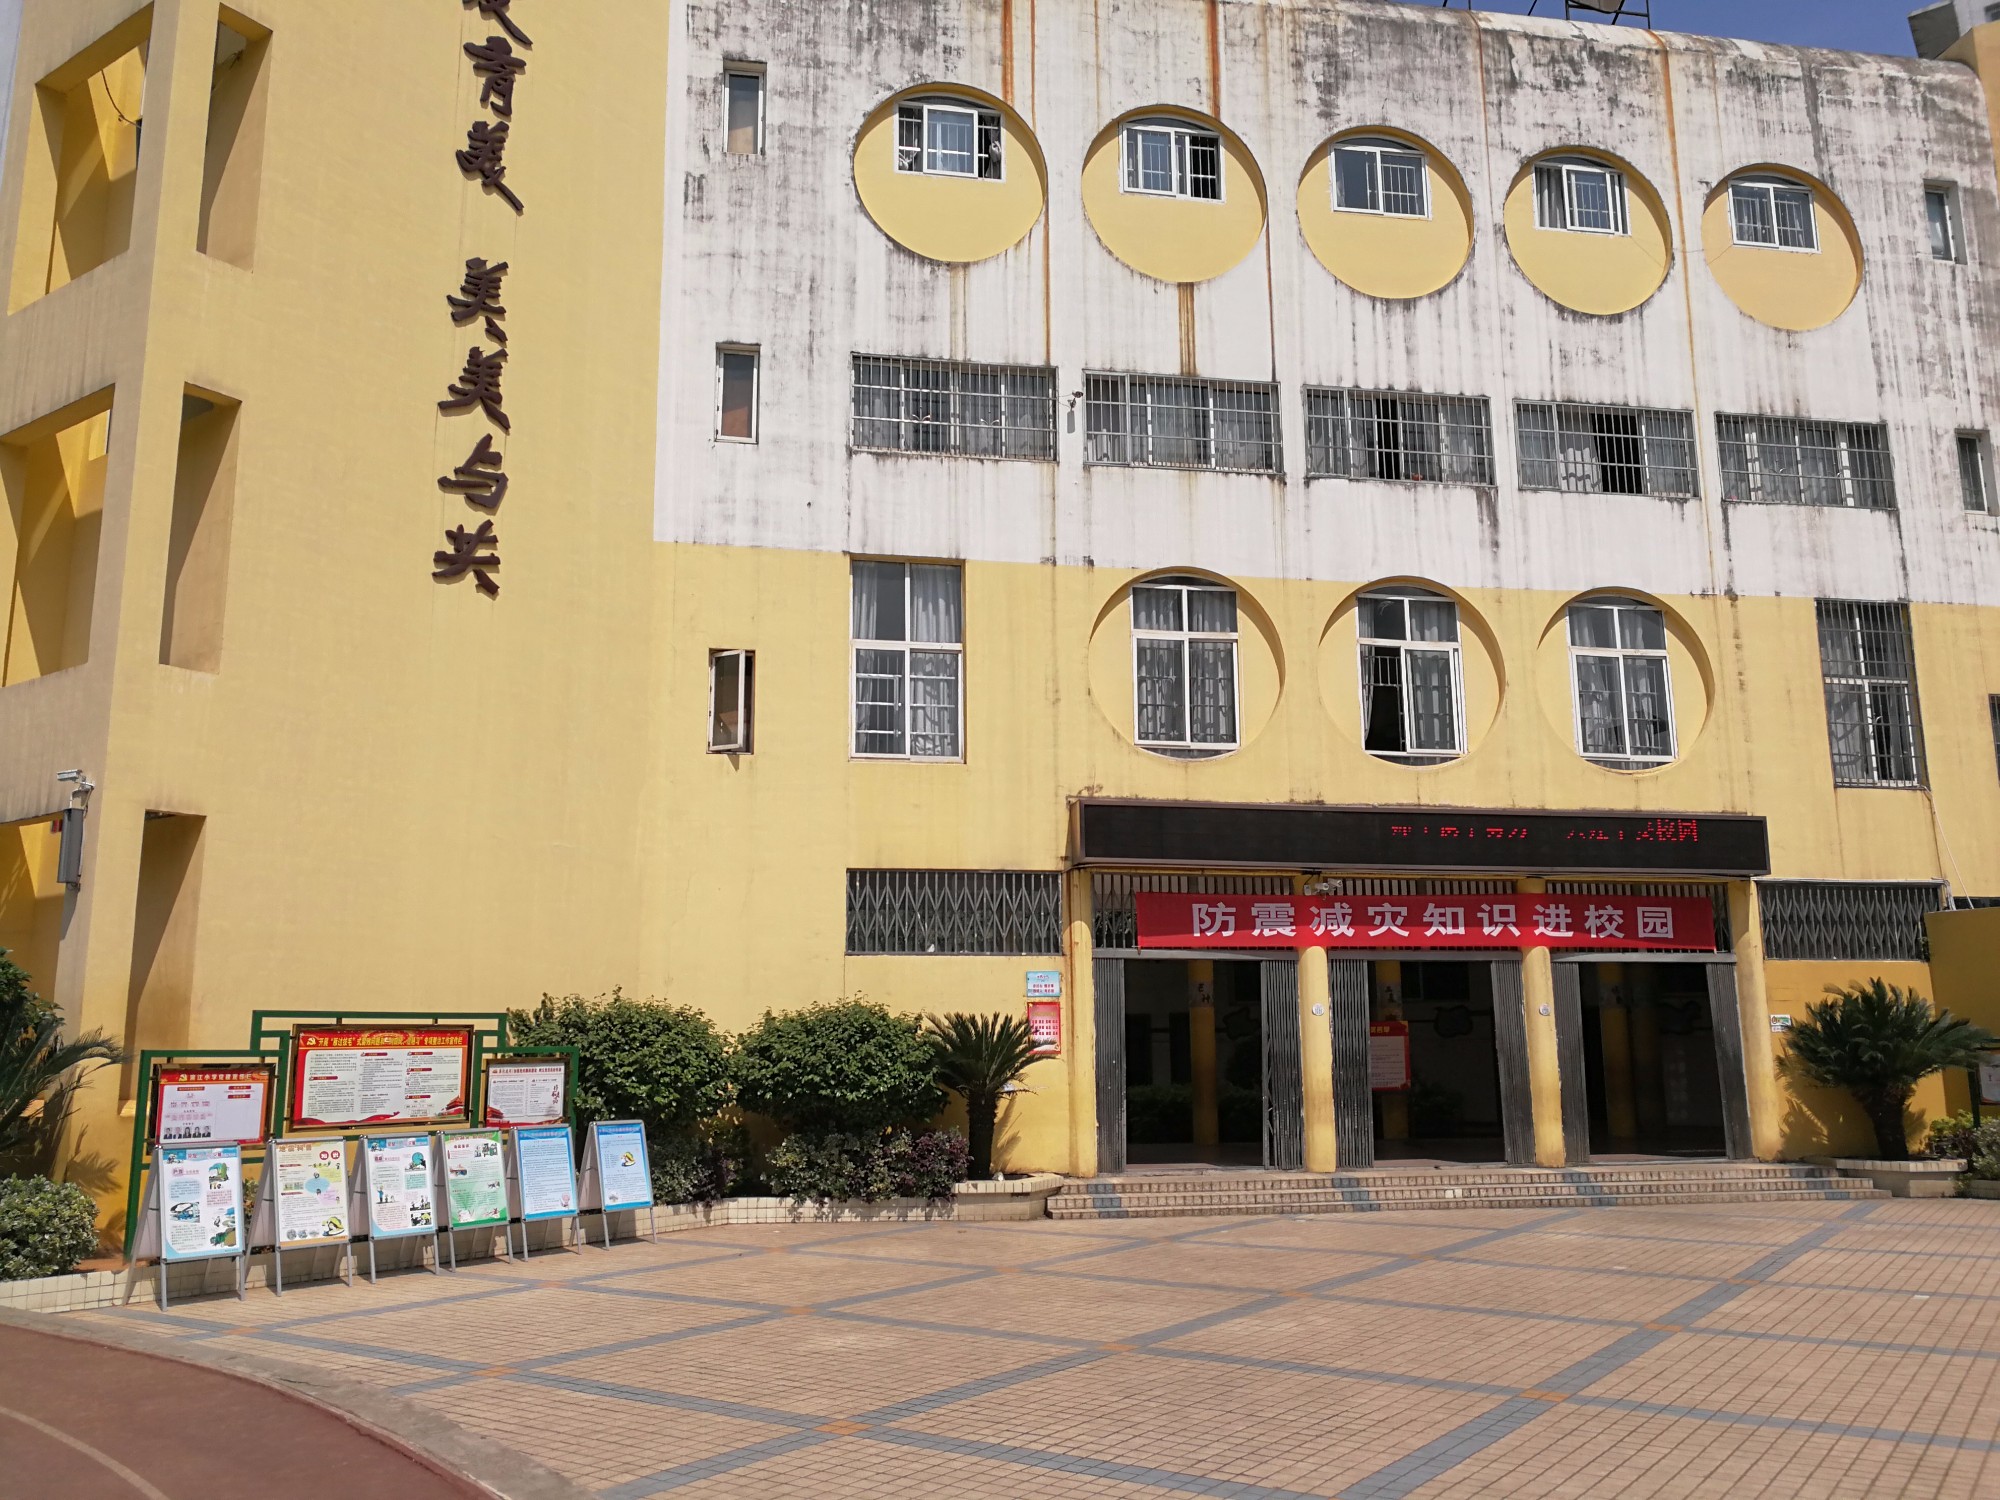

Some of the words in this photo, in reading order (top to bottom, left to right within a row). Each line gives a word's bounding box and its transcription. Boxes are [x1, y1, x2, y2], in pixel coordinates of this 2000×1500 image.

[1191, 902, 1674, 940] 防震减灾知识进校园
